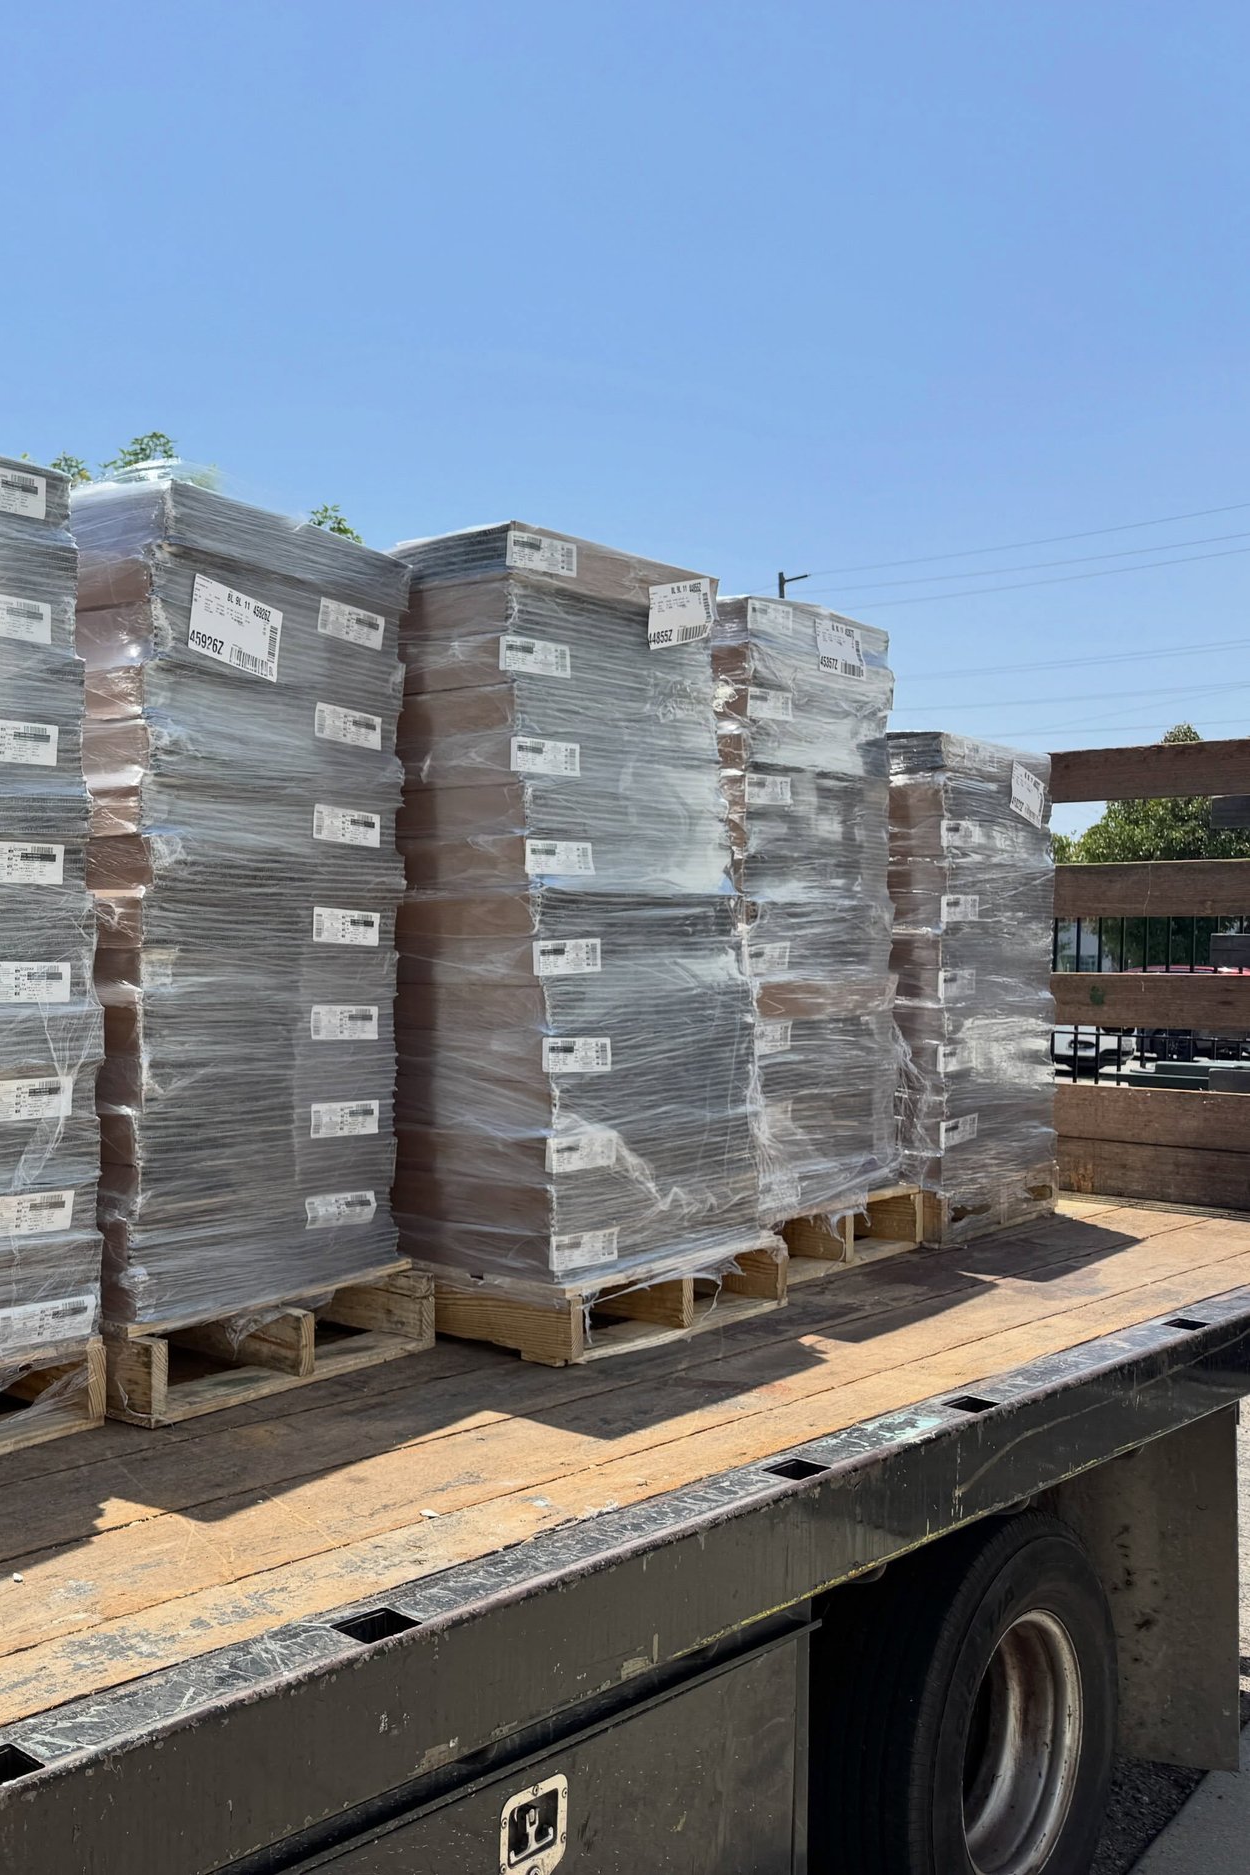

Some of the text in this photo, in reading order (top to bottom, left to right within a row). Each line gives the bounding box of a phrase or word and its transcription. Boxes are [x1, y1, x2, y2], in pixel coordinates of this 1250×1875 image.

[236, 596, 242, 606] 9L
[244, 601, 250, 610] 11
[190, 630, 224, 655] 45926Z
